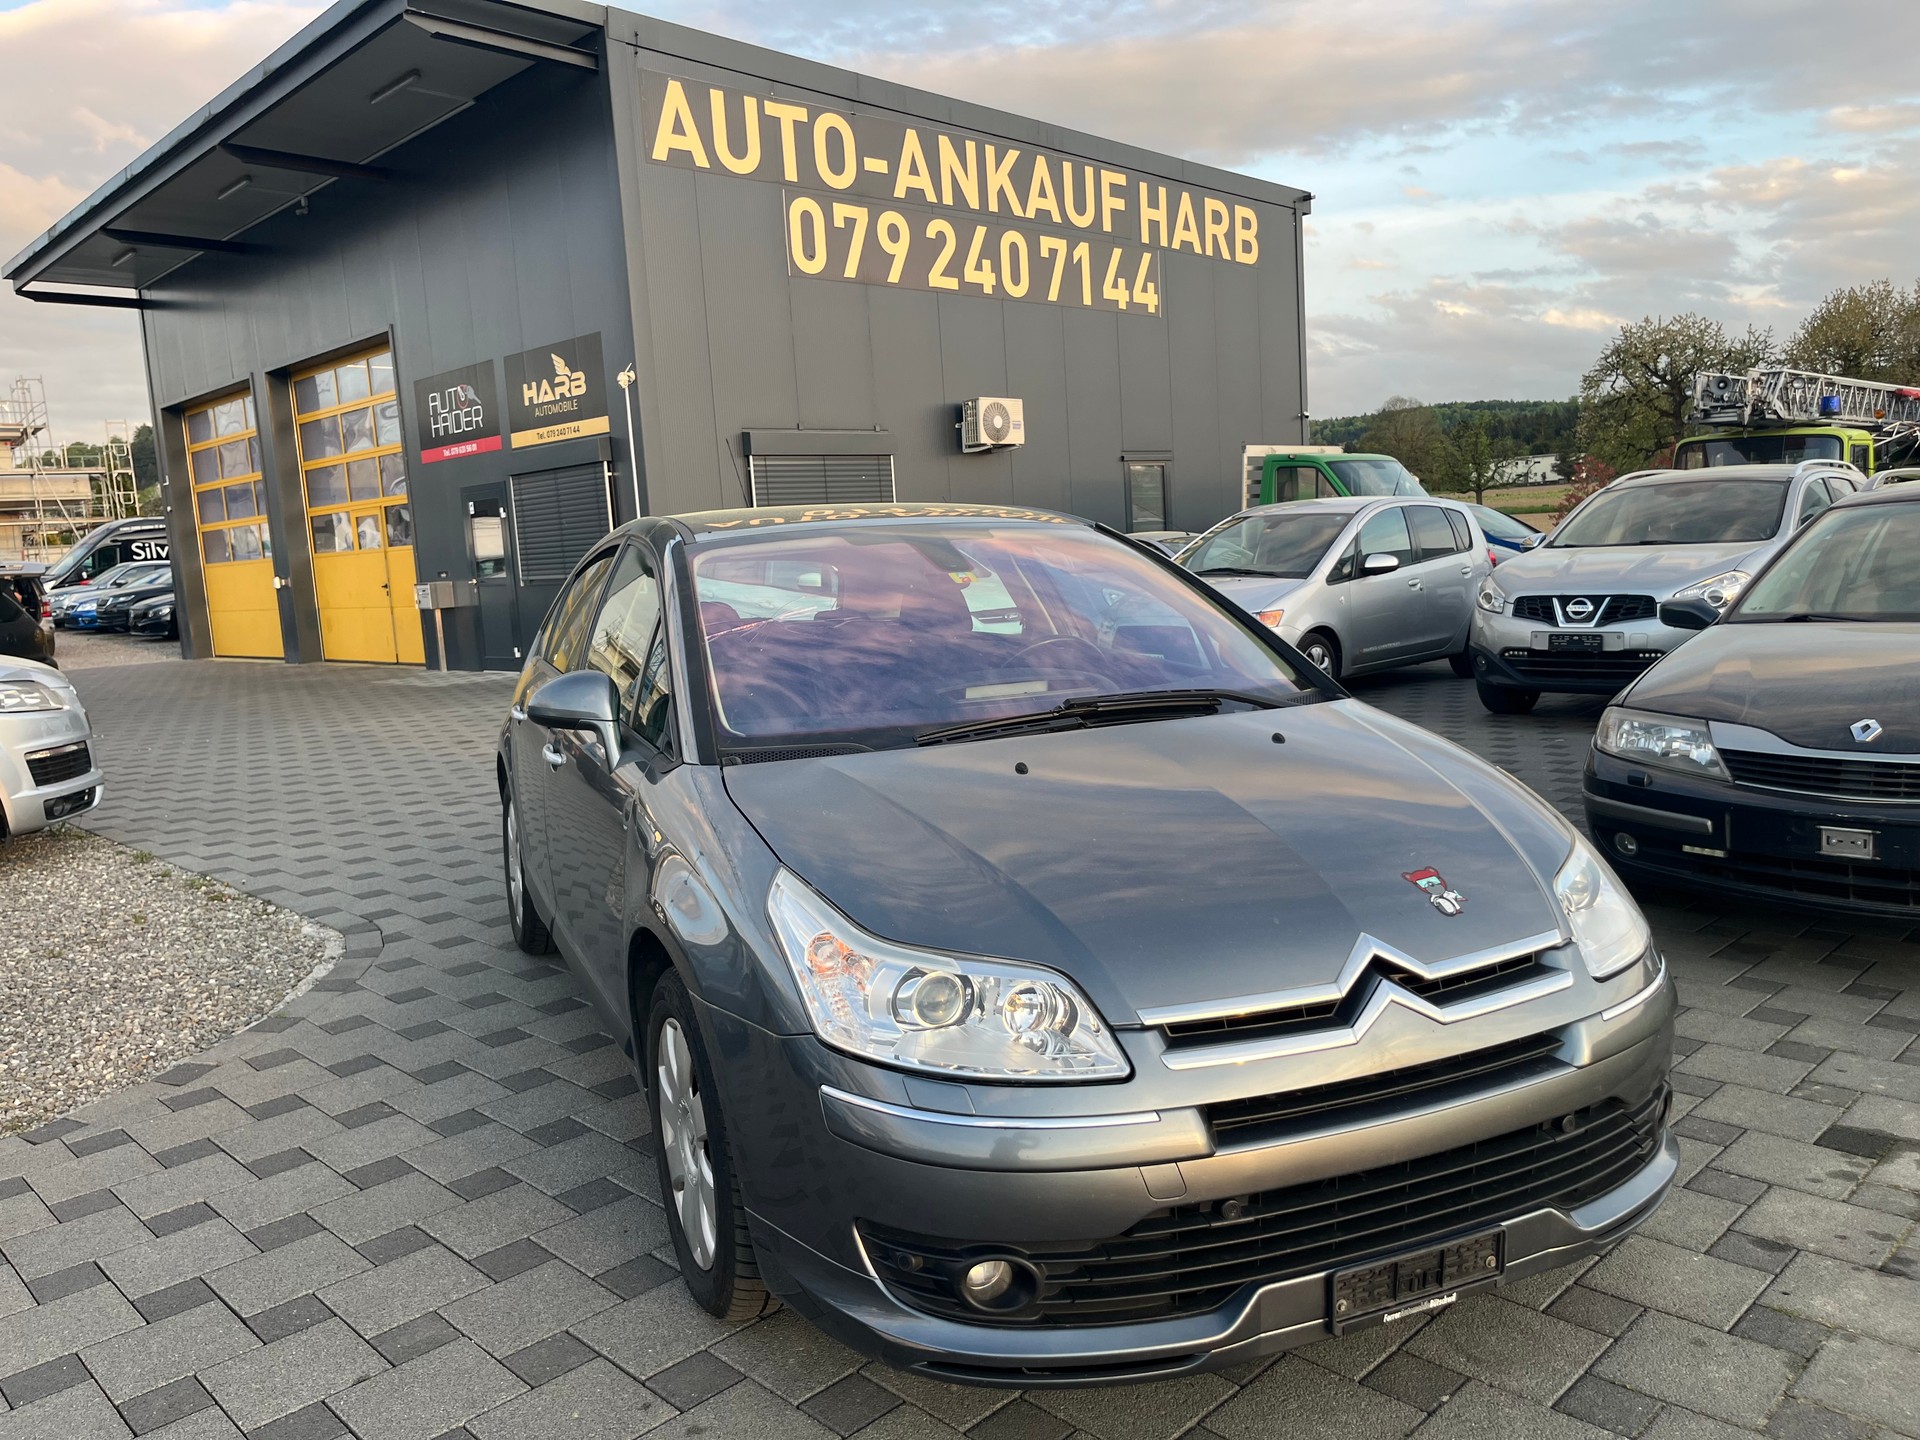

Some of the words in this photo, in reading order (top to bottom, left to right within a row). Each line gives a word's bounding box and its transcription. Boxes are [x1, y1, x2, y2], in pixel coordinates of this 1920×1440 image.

[652, 79, 1127, 233] AUTO-ANKAUF
[1139, 181, 1259, 265] HARB
[789, 197, 910, 283] 079
[925, 218, 1030, 298] 240
[1039, 235, 1092, 306] 71
[1103, 247, 1159, 313] 44
[522, 371, 587, 407] HARB
[430, 405, 484, 438] HAIDER
[534, 399, 579, 418] AUTOMOBILE
